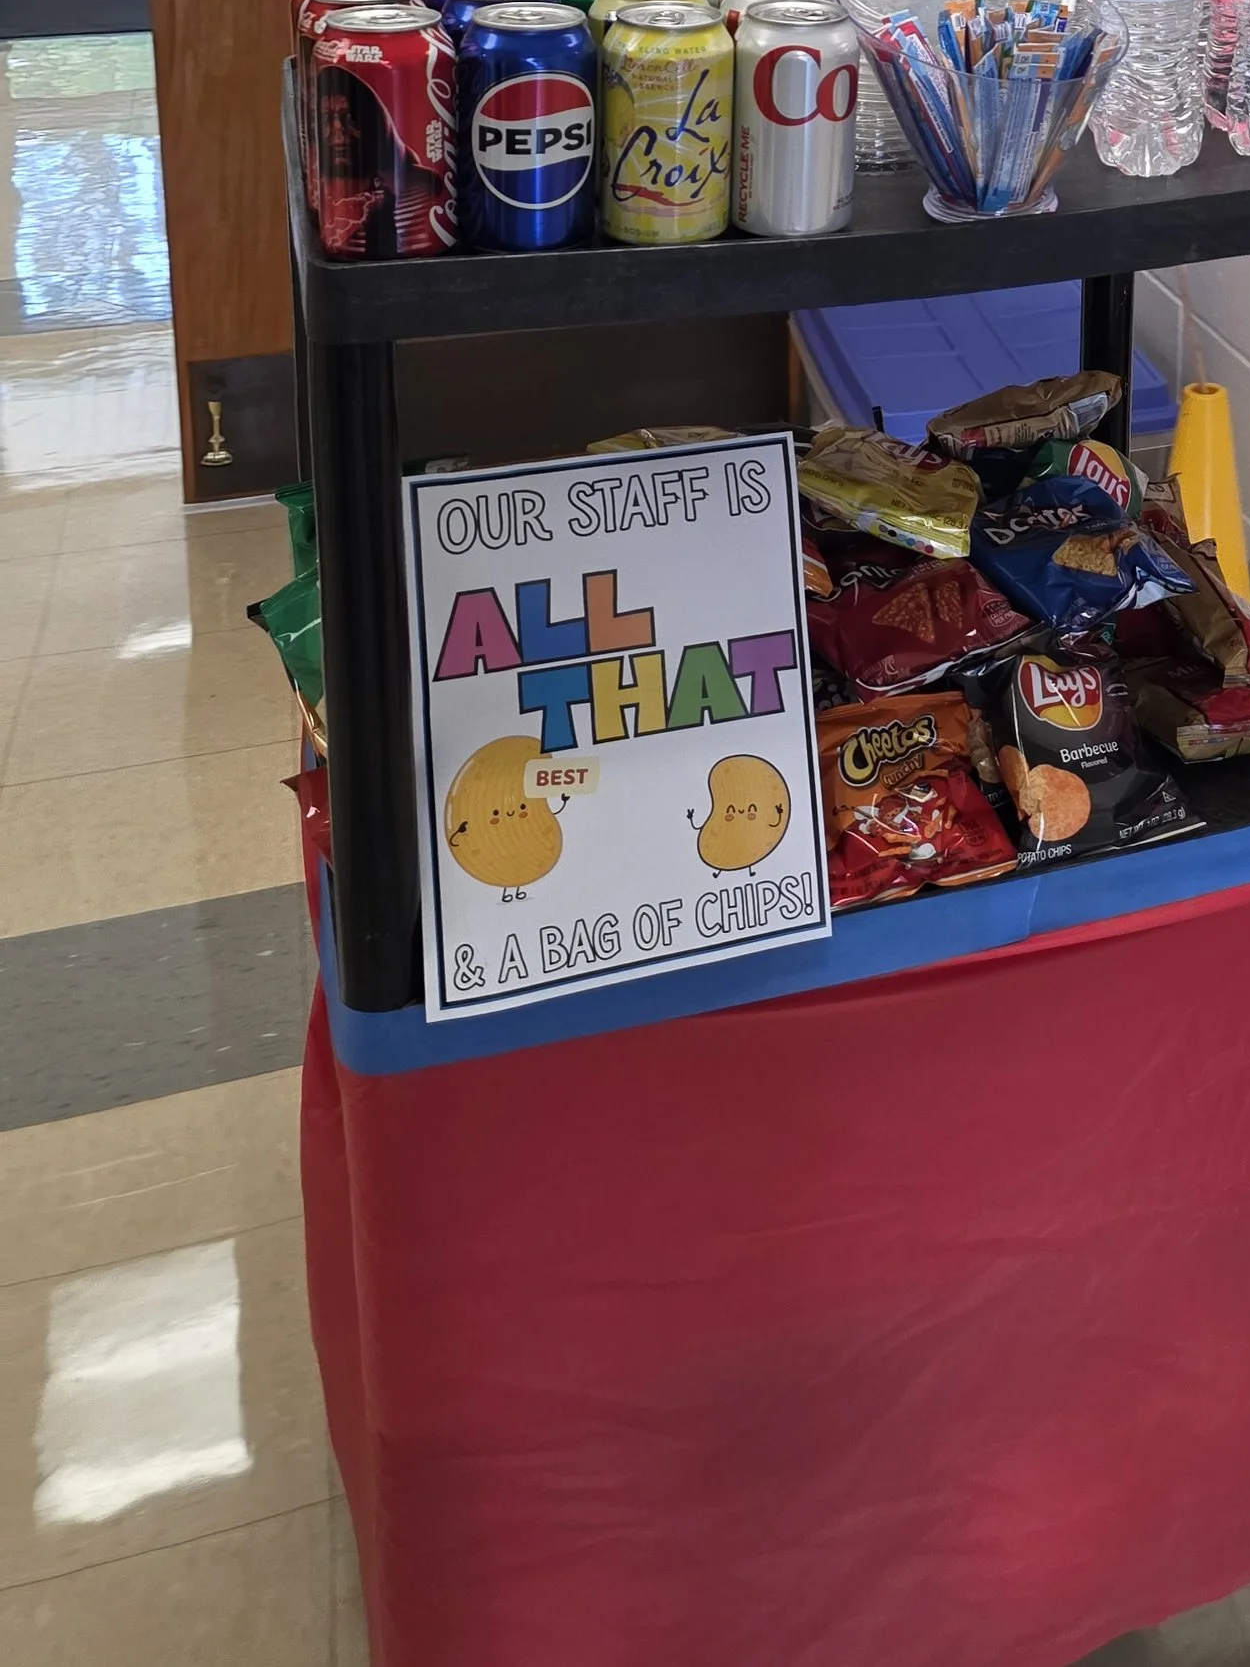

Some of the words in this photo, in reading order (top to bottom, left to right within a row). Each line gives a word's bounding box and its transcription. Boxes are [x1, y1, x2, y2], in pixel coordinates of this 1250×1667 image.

[345, 53, 383, 64] WARS
[351, 45, 382, 55] STAR
[665, 69, 722, 143] La
[479, 118, 592, 155] PEPSI
[740, 124, 751, 151] ME
[612, 125, 729, 202] Croix
[739, 152, 750, 223] RECYCLE
[437, 489, 552, 555] OUR
[568, 466, 710, 537] STAFF
[725, 460, 771, 517] IS
[983, 503, 1091, 546] Doritos
[432, 569, 656, 681] ALL
[517, 629, 798, 753] THAT
[840, 716, 934, 784] Cheetos
[1059, 740, 1120, 763] Barbecue
[1081, 756, 1108, 770] Flavored
[536, 767, 589, 787] BEST
[1017, 849, 1046, 863] POTATO
[1047, 843, 1073, 859] CHIPS
[453, 943, 485, 991] &
[498, 933, 528, 984] A
[540, 912, 621, 974] BAG
[632, 898, 684, 951] OF
[695, 871, 814, 937] CHIPS!
